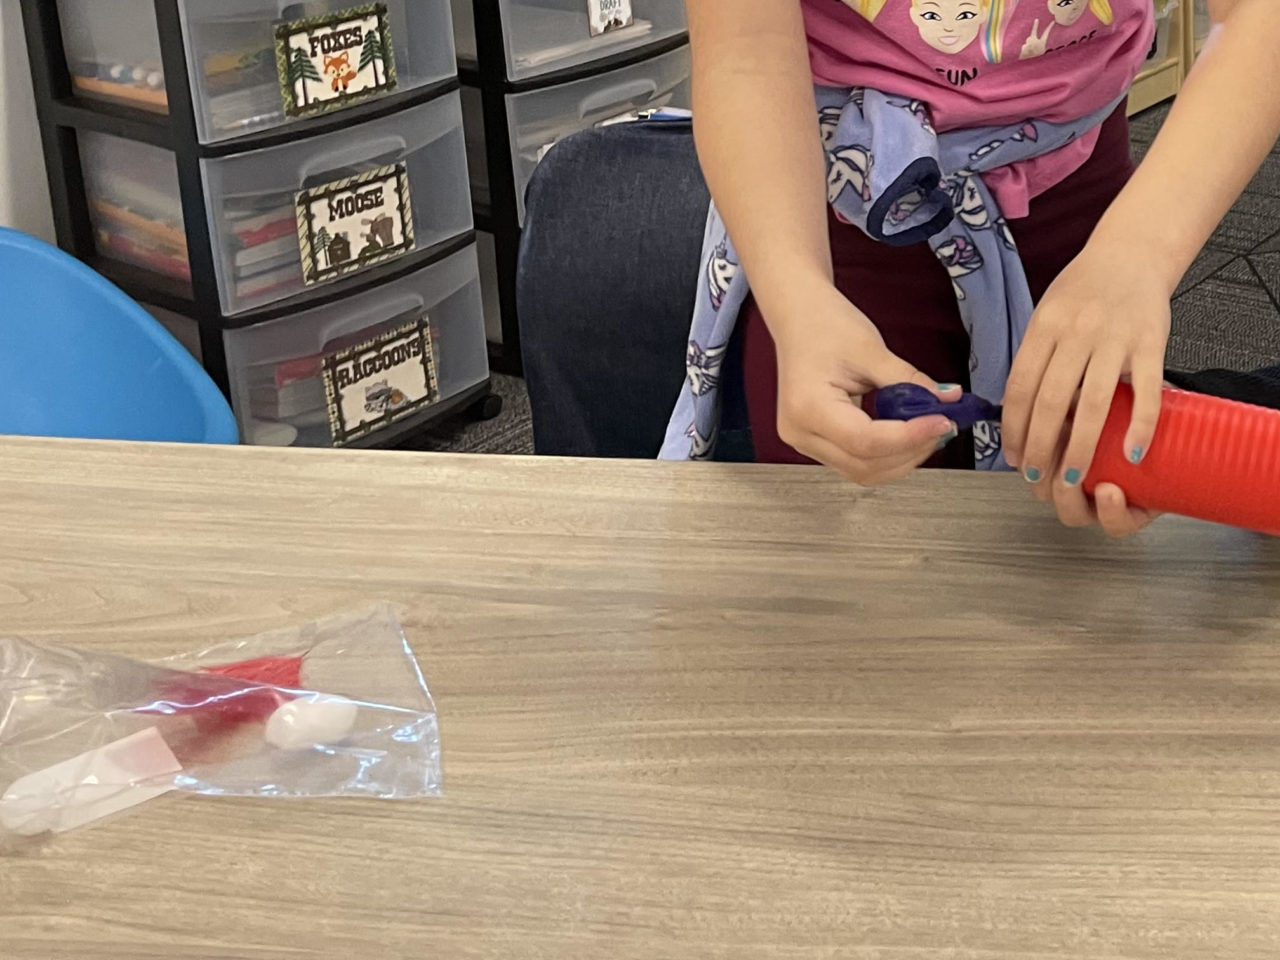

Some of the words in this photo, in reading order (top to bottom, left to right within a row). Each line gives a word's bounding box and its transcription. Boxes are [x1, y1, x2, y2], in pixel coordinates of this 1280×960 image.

[309, 25, 365, 60] FOXES
[329, 186, 386, 223] MOOSE
[339, 341, 423, 389] RACCOONS
